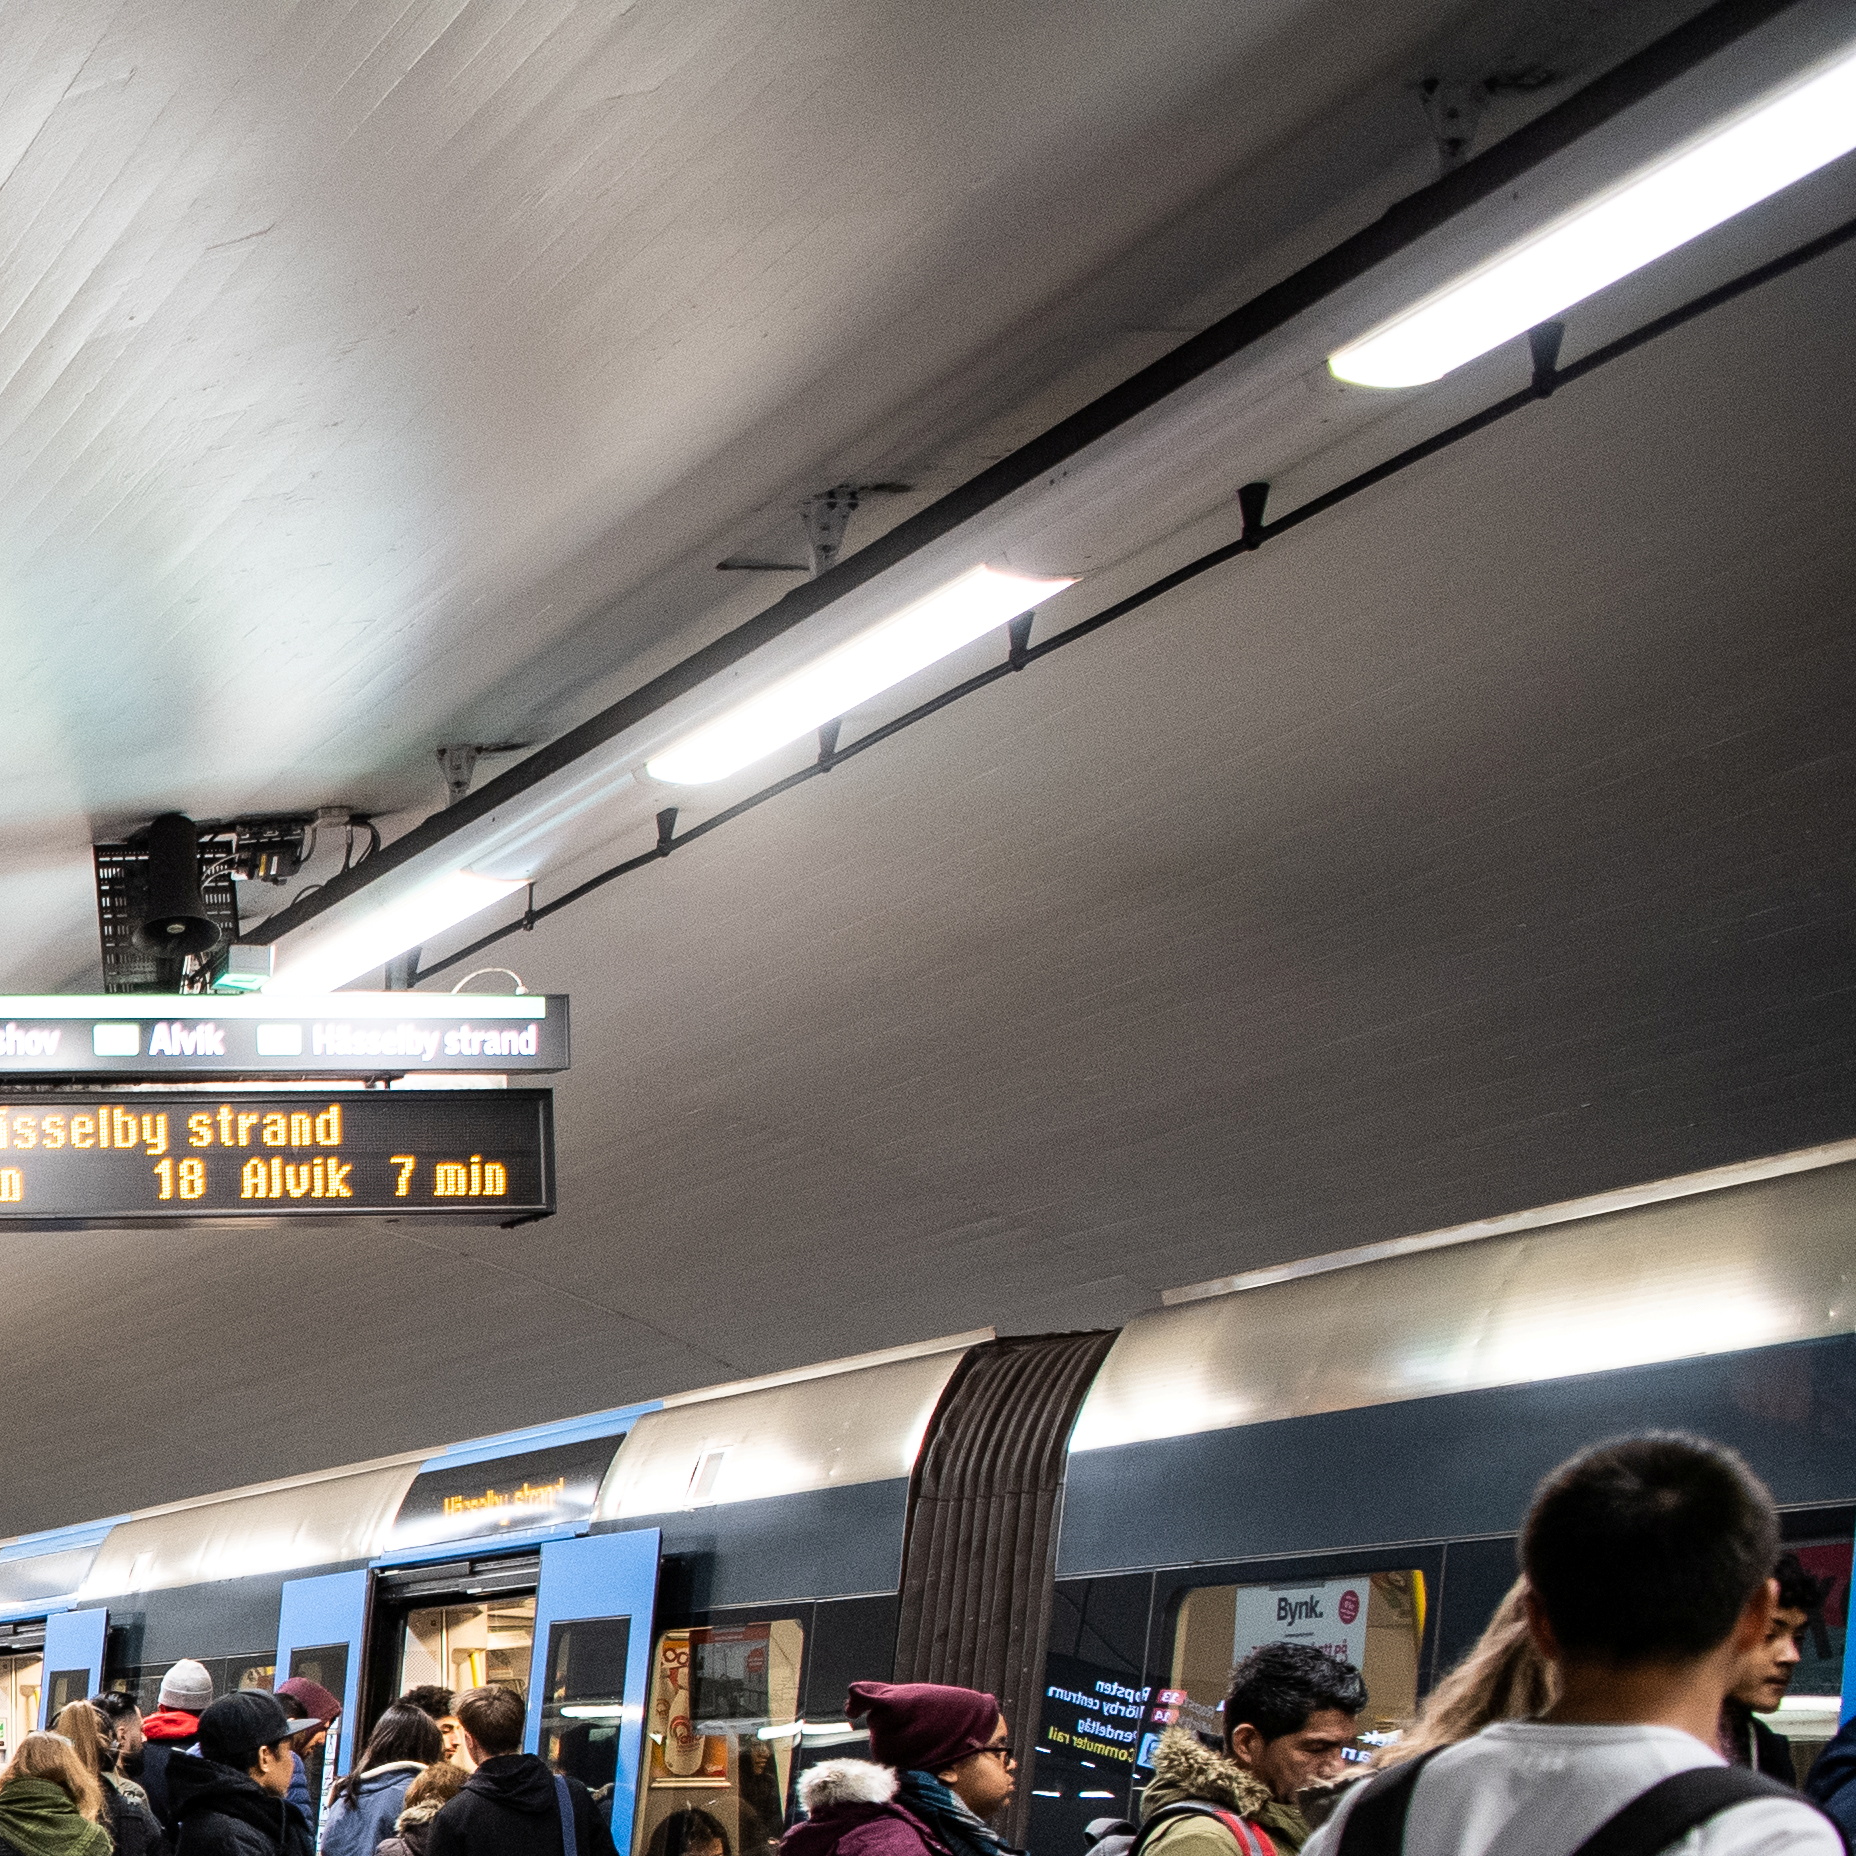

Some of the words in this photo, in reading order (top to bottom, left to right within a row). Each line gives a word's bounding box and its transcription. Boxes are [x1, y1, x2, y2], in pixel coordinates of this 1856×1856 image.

[148, 1022, 225, 1057] Alvik
[312, 1022, 440, 1062] Hässelby
[443, 1023, 537, 1056] strand
[187, 1103, 344, 1148] strand
[153, 1156, 207, 1200] 18
[239, 1155, 354, 1199] Alvik
[389, 1154, 417, 1197] 7
[432, 1153, 509, 1197] min
[1277, 1594, 1324, 1627] Bynk.
